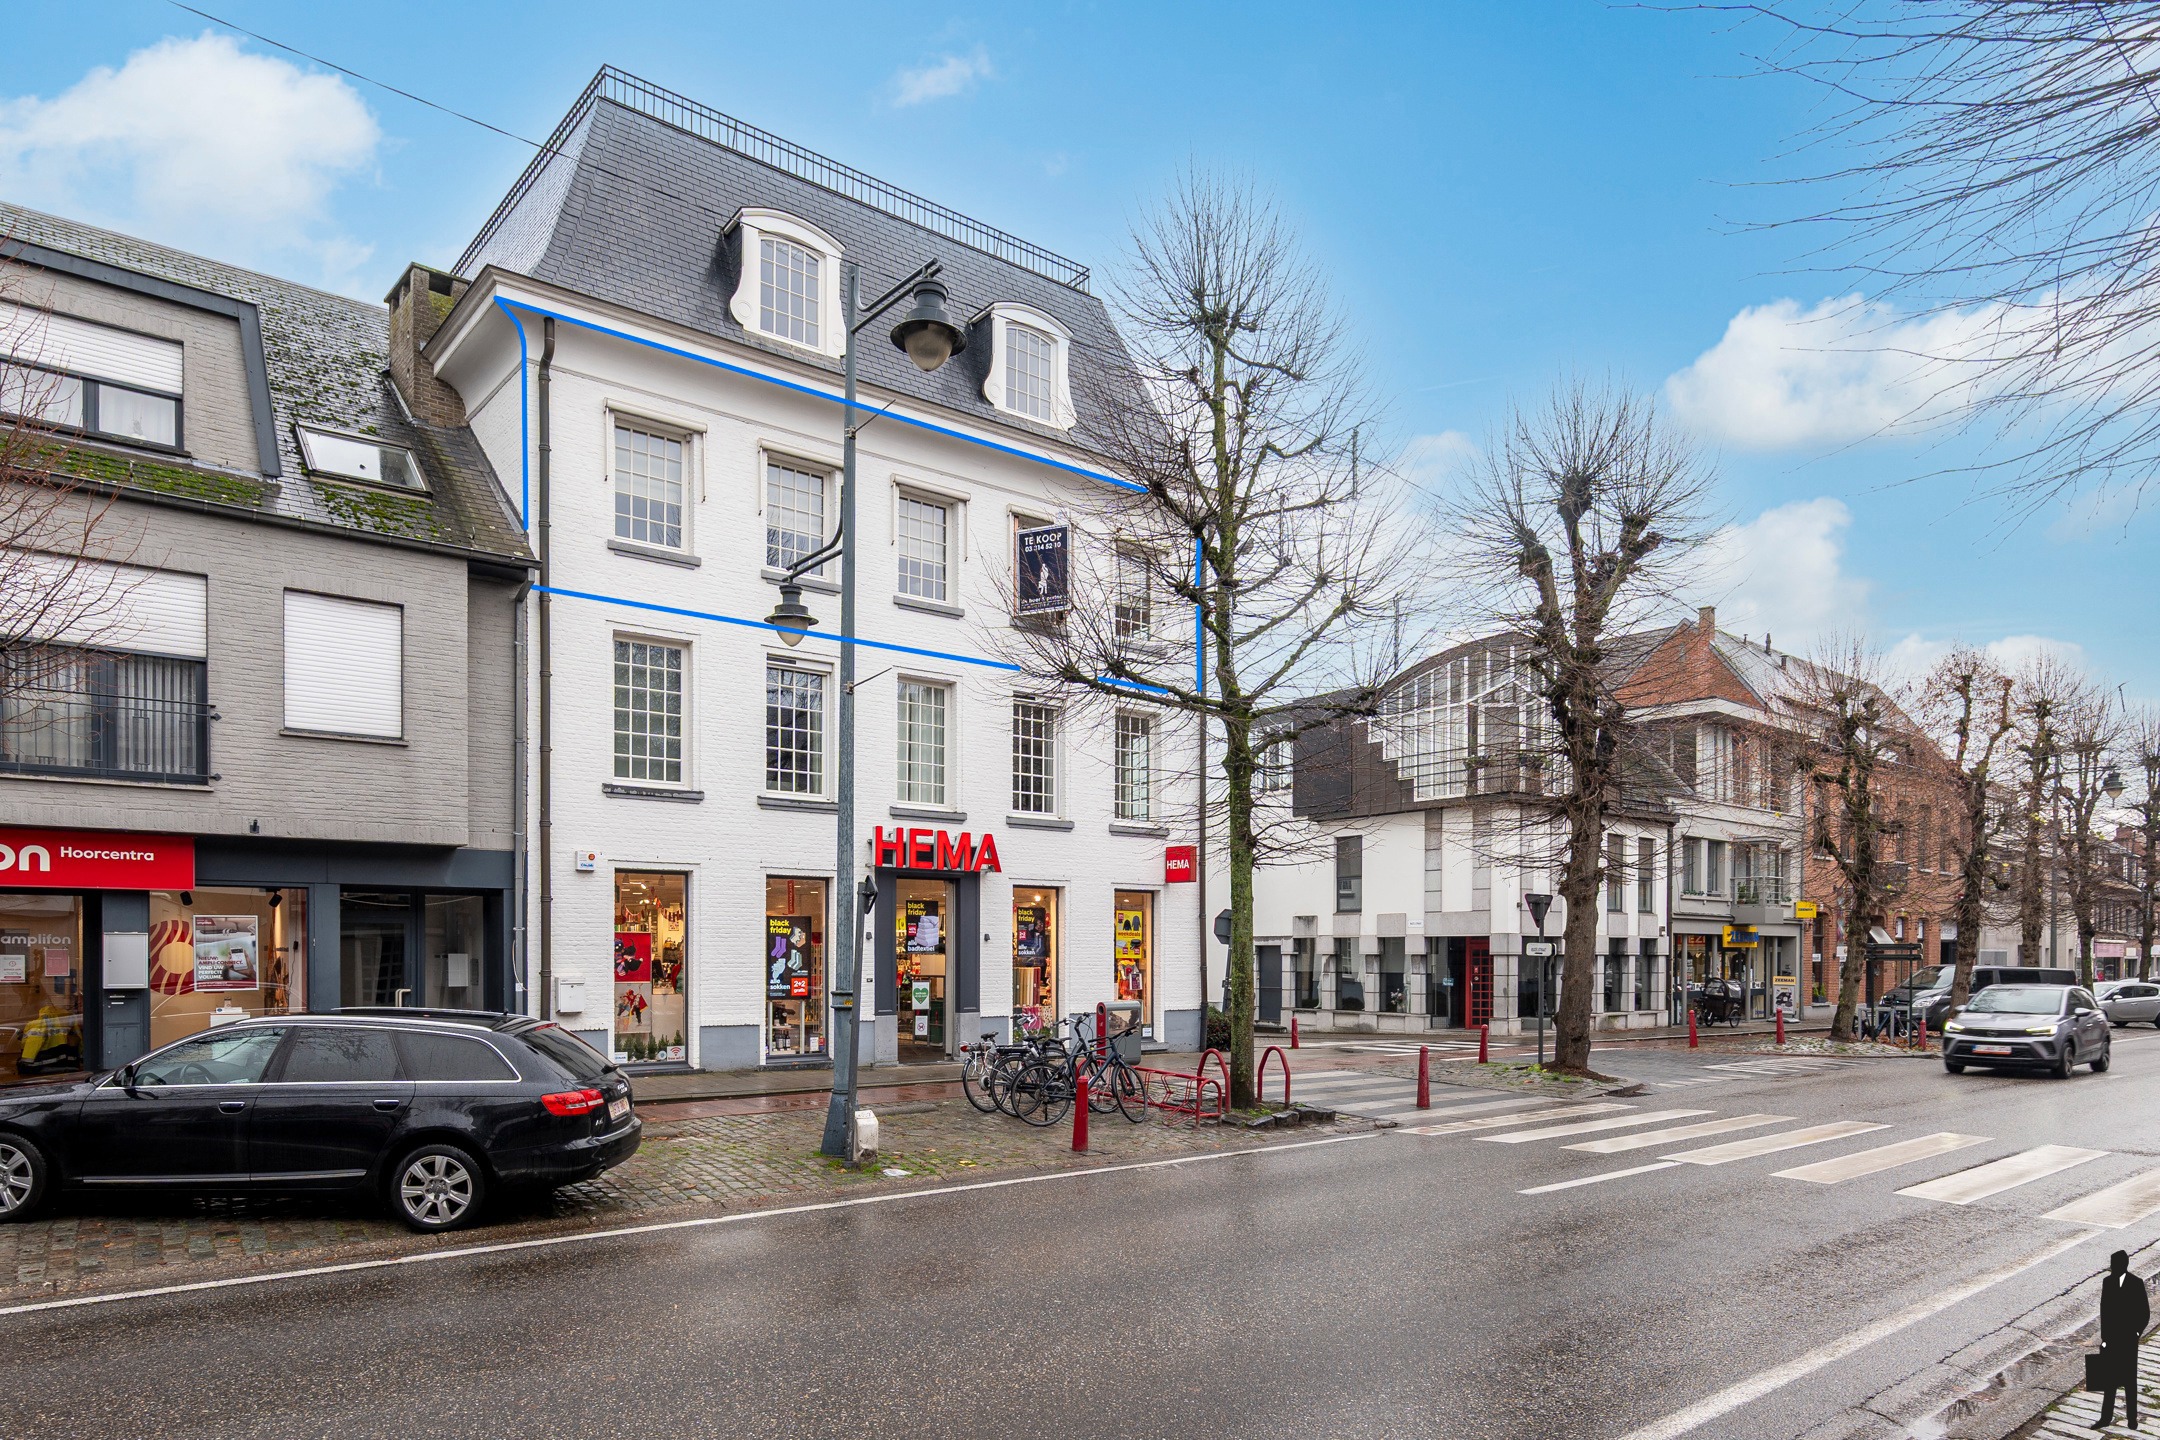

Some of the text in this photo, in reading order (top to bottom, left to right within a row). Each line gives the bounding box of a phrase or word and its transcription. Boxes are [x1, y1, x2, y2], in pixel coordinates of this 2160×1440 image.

[1024, 533, 1062, 546] TE KOOP
[60, 846, 155, 861] Hoorcentra
[874, 825, 1002, 873] HEMA
[1166, 859, 1190, 870] HEMA
[907, 909, 927, 917] friday
[769, 919, 790, 927] black
[1018, 915, 1035, 923] friday
[769, 927, 792, 935] friday
[0, 934, 72, 947] amplifon
[793, 980, 806, 988] 2+2
